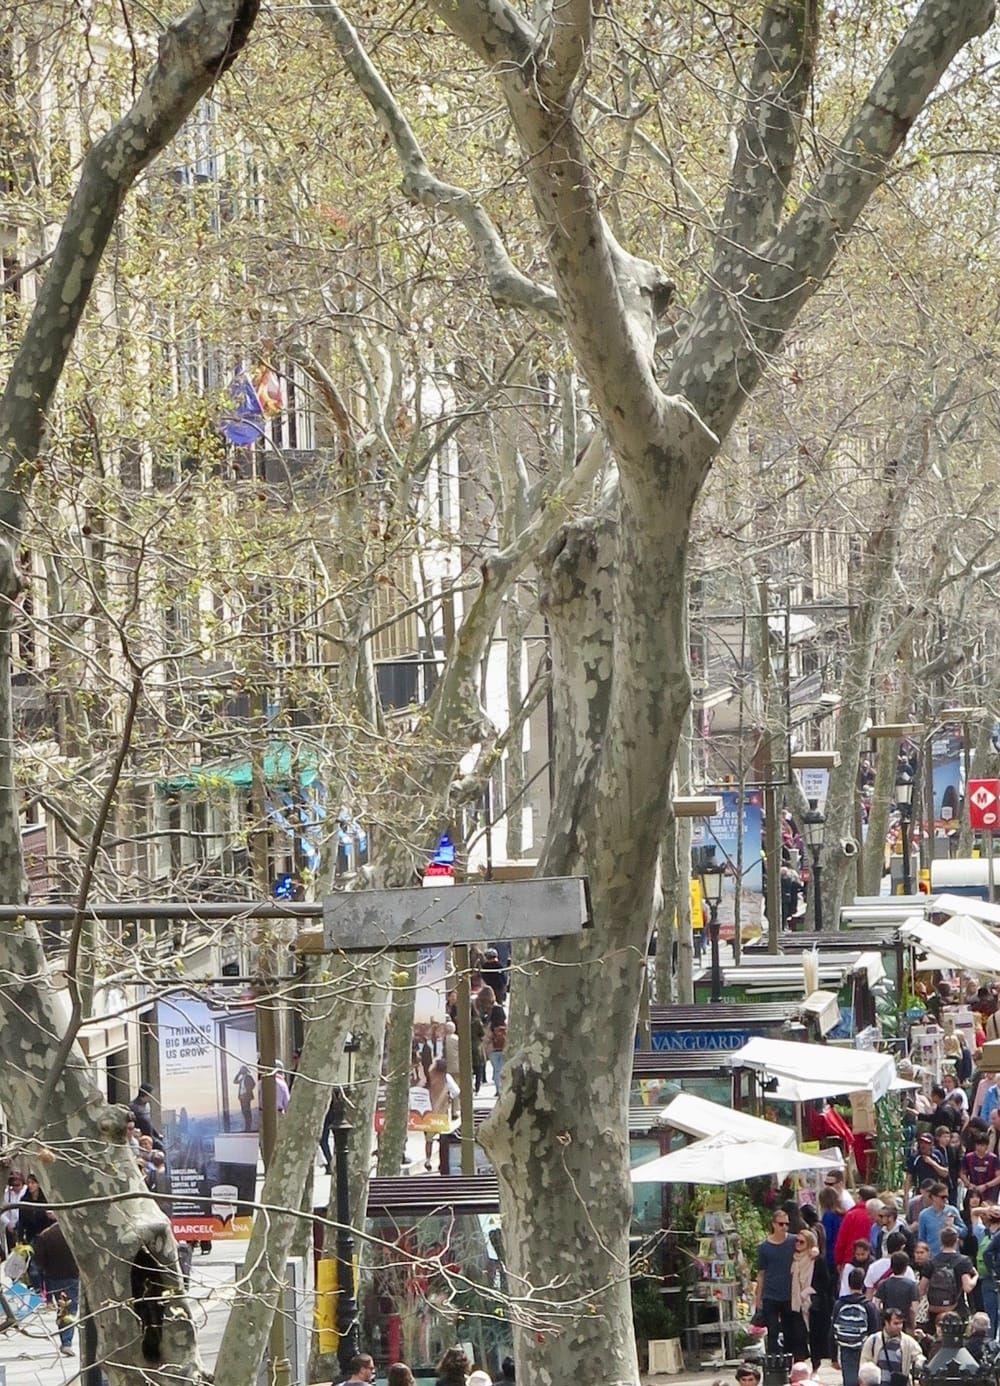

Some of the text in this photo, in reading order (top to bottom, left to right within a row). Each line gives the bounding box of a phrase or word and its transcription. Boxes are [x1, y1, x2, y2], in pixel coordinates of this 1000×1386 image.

[977, 792, 987, 803] M
[170, 1024, 212, 1036] THINKNG
[651, 1035, 745, 1050] VANGUARDI
[165, 1049, 177, 1059] US
